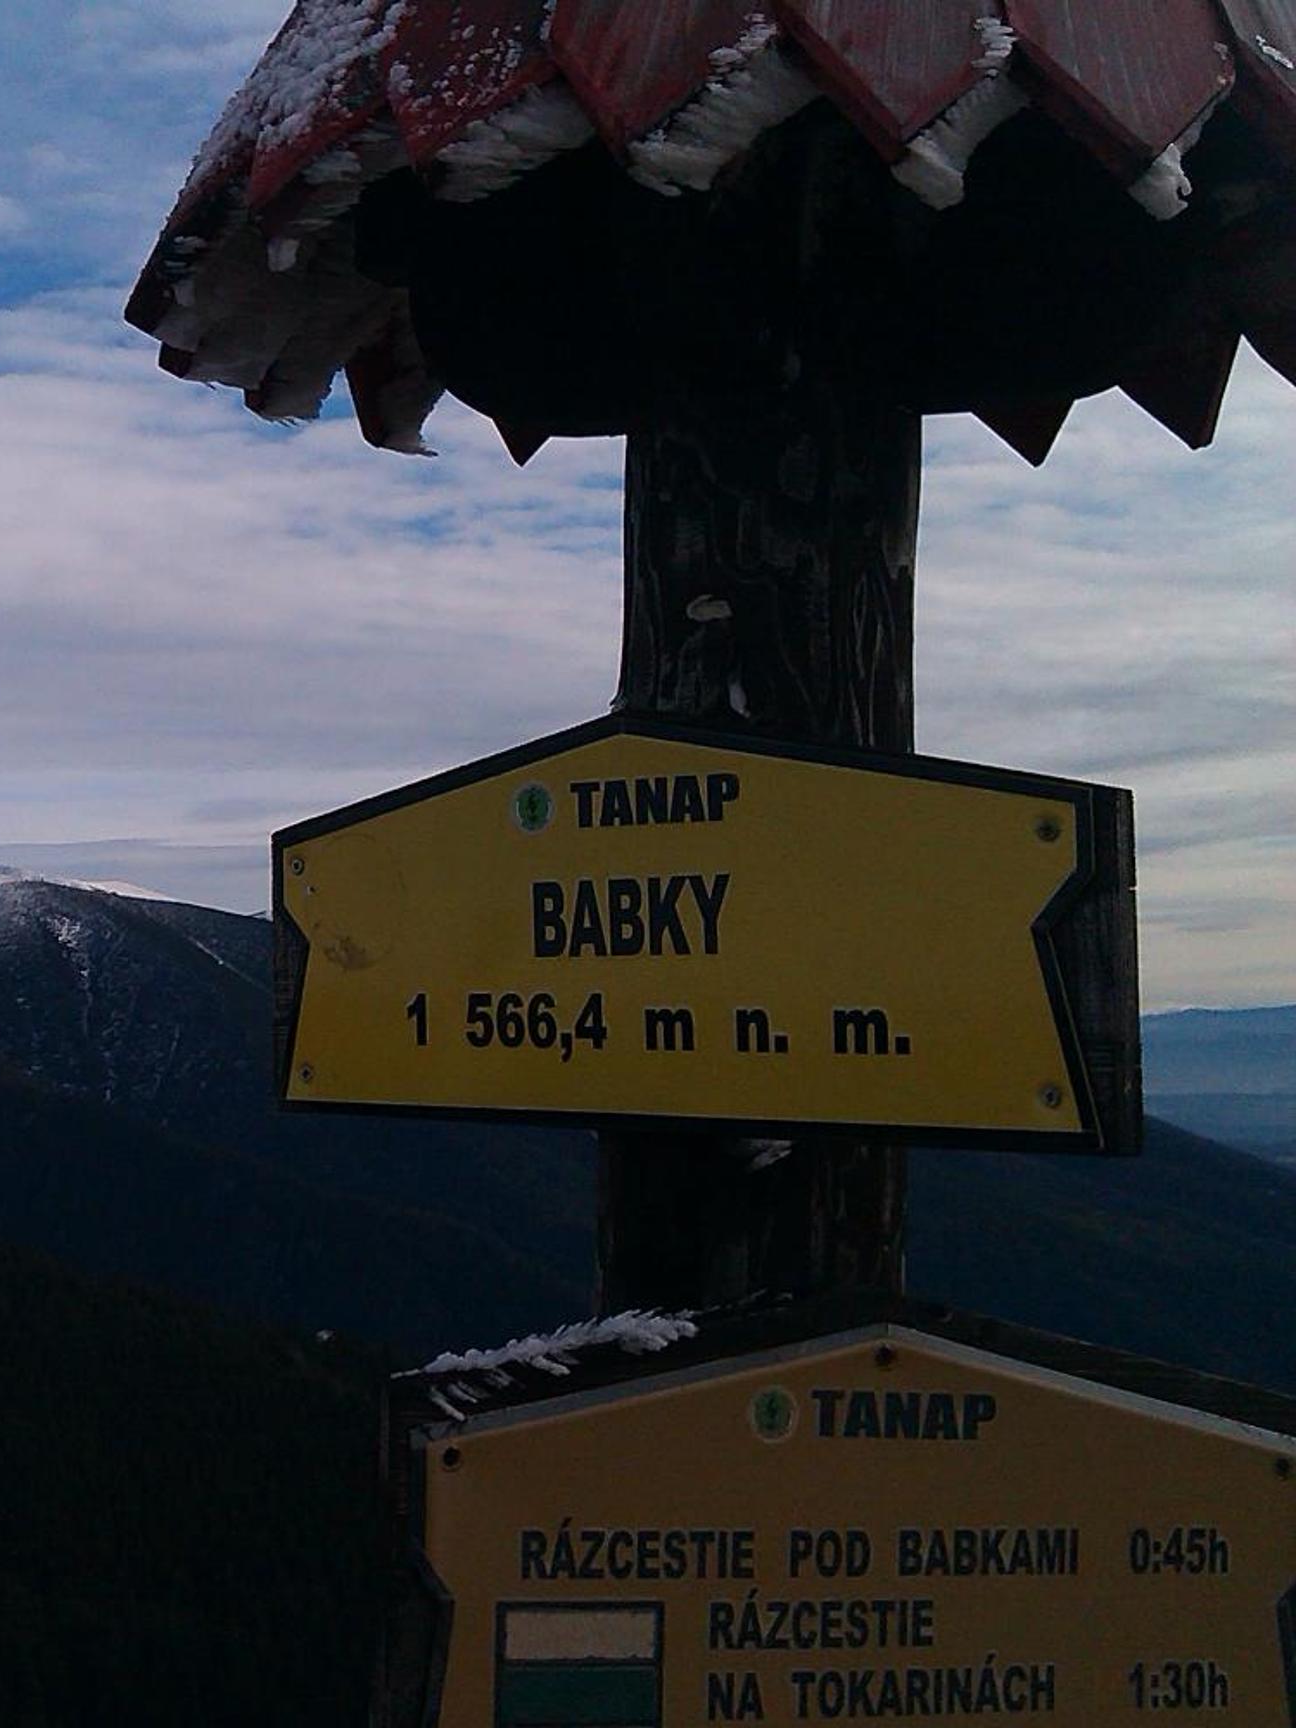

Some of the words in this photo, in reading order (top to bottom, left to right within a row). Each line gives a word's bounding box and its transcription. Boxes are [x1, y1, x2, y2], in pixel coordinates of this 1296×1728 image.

[571, 774, 740, 828] TANAP
[531, 874, 731, 957] BABKY
[406, 992, 429, 1047] 1
[465, 992, 606, 1062] 566,4
[645, 1007, 694, 1051] m
[735, 1007, 789, 1054] n.
[833, 1007, 912, 1055] m.
[811, 1389, 996, 1440] TANAP
[521, 1517, 753, 1580] RÁZCESTIE
[789, 1530, 871, 1578] POD
[897, 1529, 1080, 1578] BABKAMI
[1129, 1529, 1229, 1575] 0:45h
[708, 1588, 934, 1650] RÁZCESTIE
[707, 1671, 761, 1720] NA
[793, 1654, 1055, 1718] TOKARINÁCH
[1129, 1661, 1229, 1711] 1:30h
